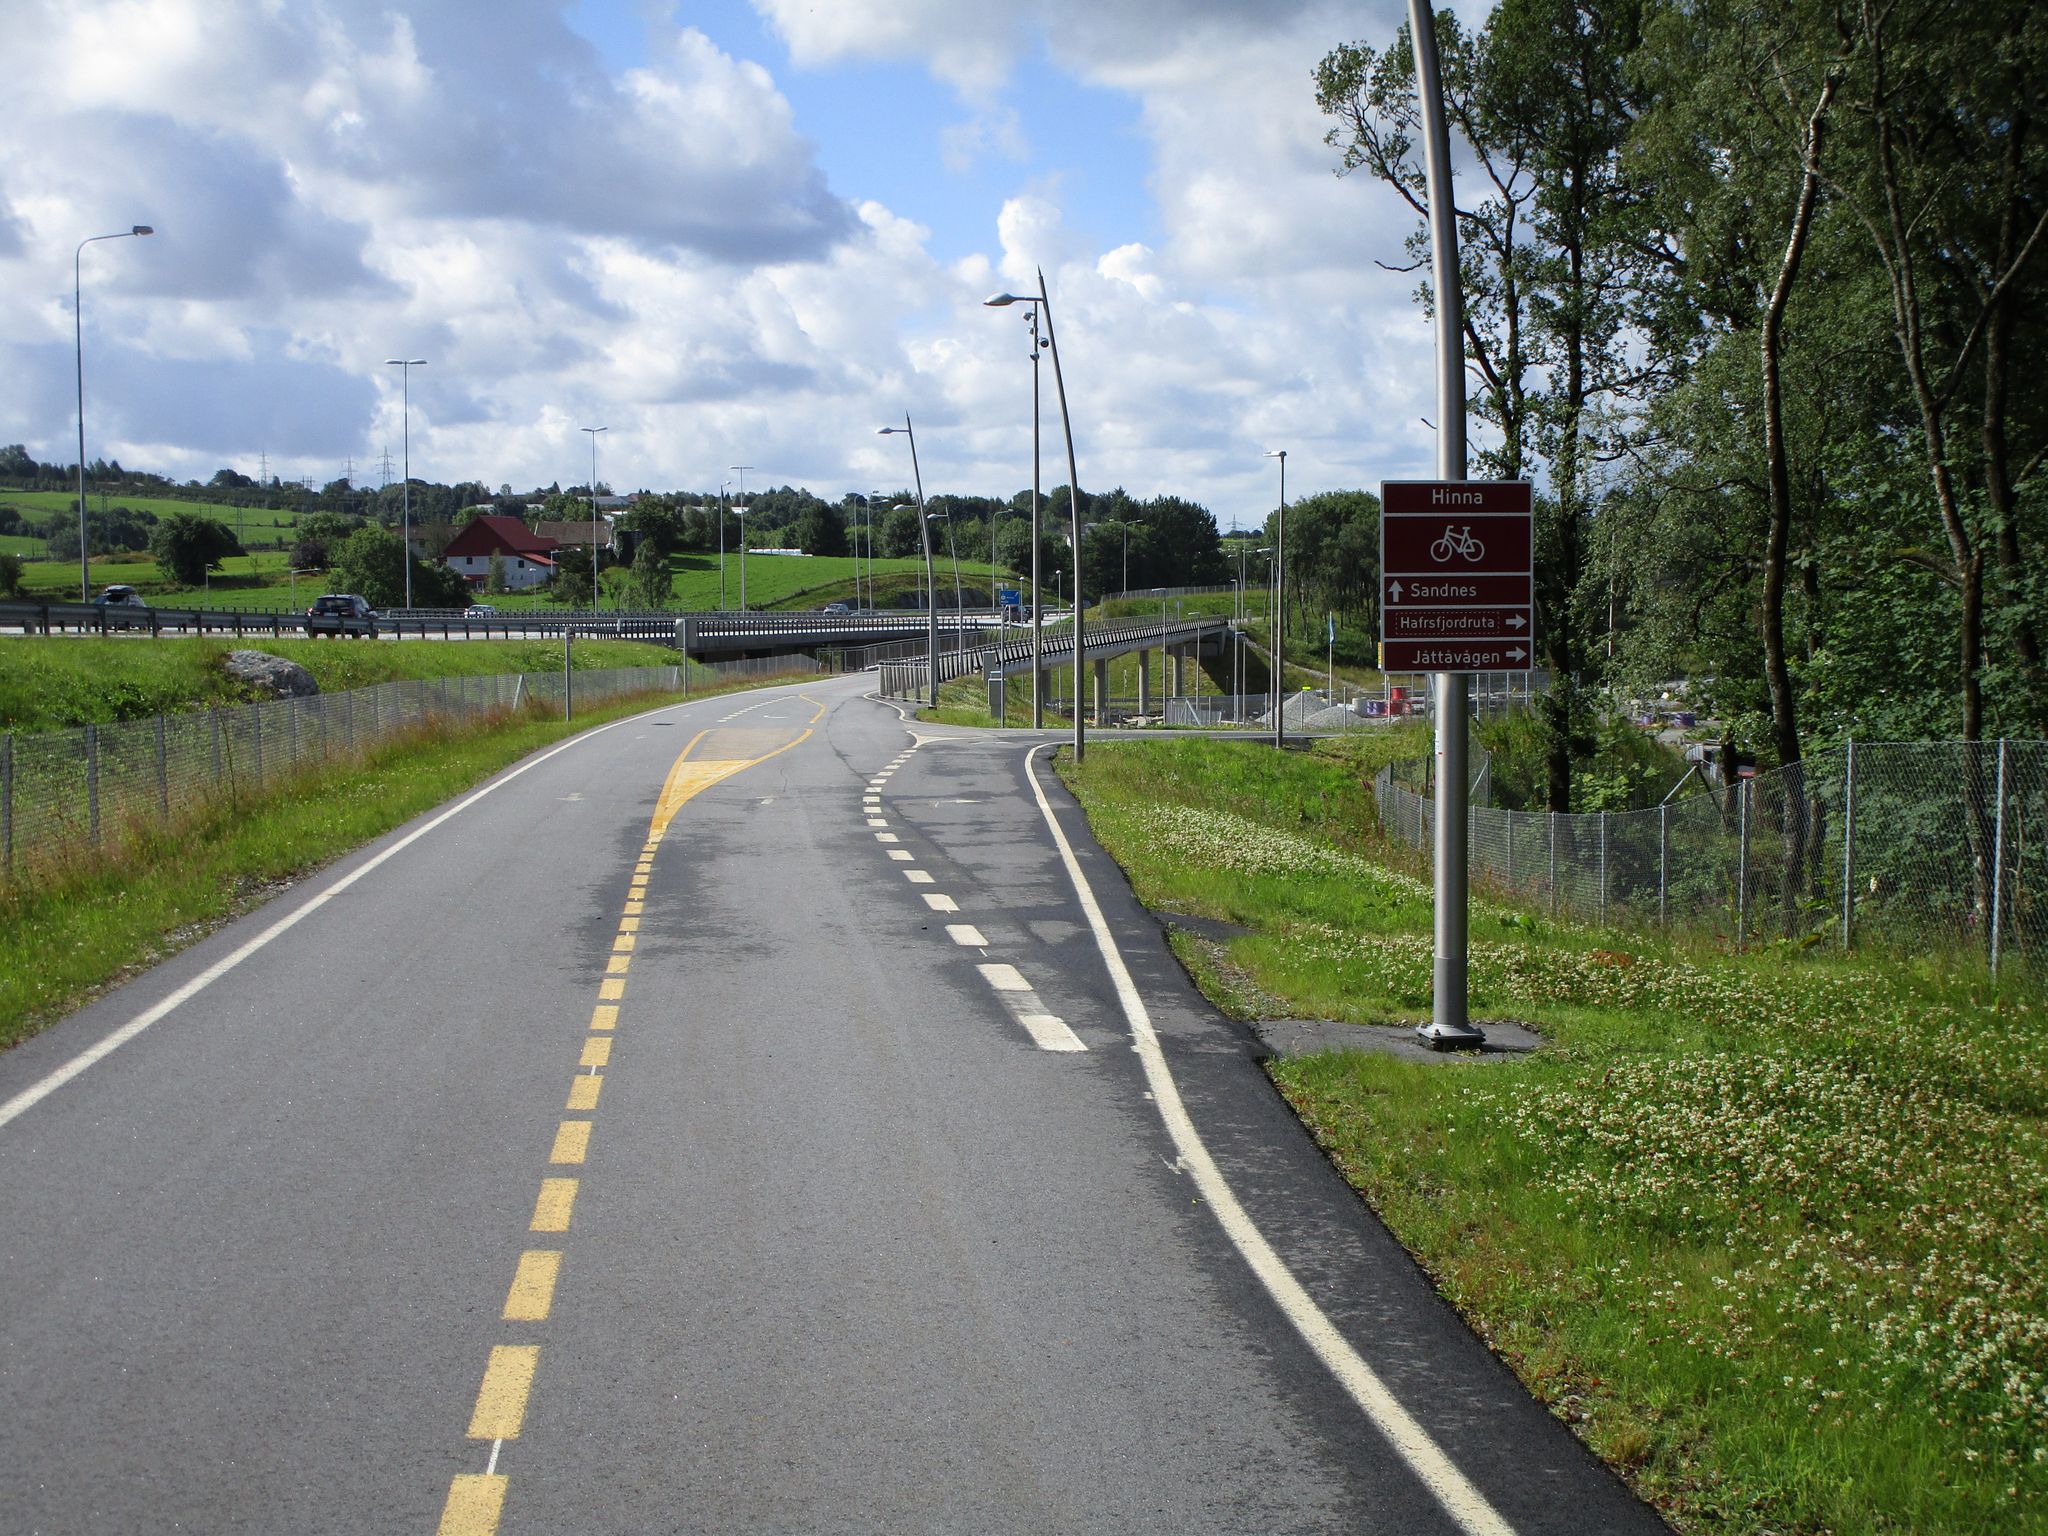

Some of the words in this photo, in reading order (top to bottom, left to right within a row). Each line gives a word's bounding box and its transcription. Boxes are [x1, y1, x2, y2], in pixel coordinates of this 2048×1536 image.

[1432, 488, 1483, 505] Hinna
[1410, 583, 1477, 598] Sandnes
[1400, 616, 1495, 632] Hafrsfjordruta
